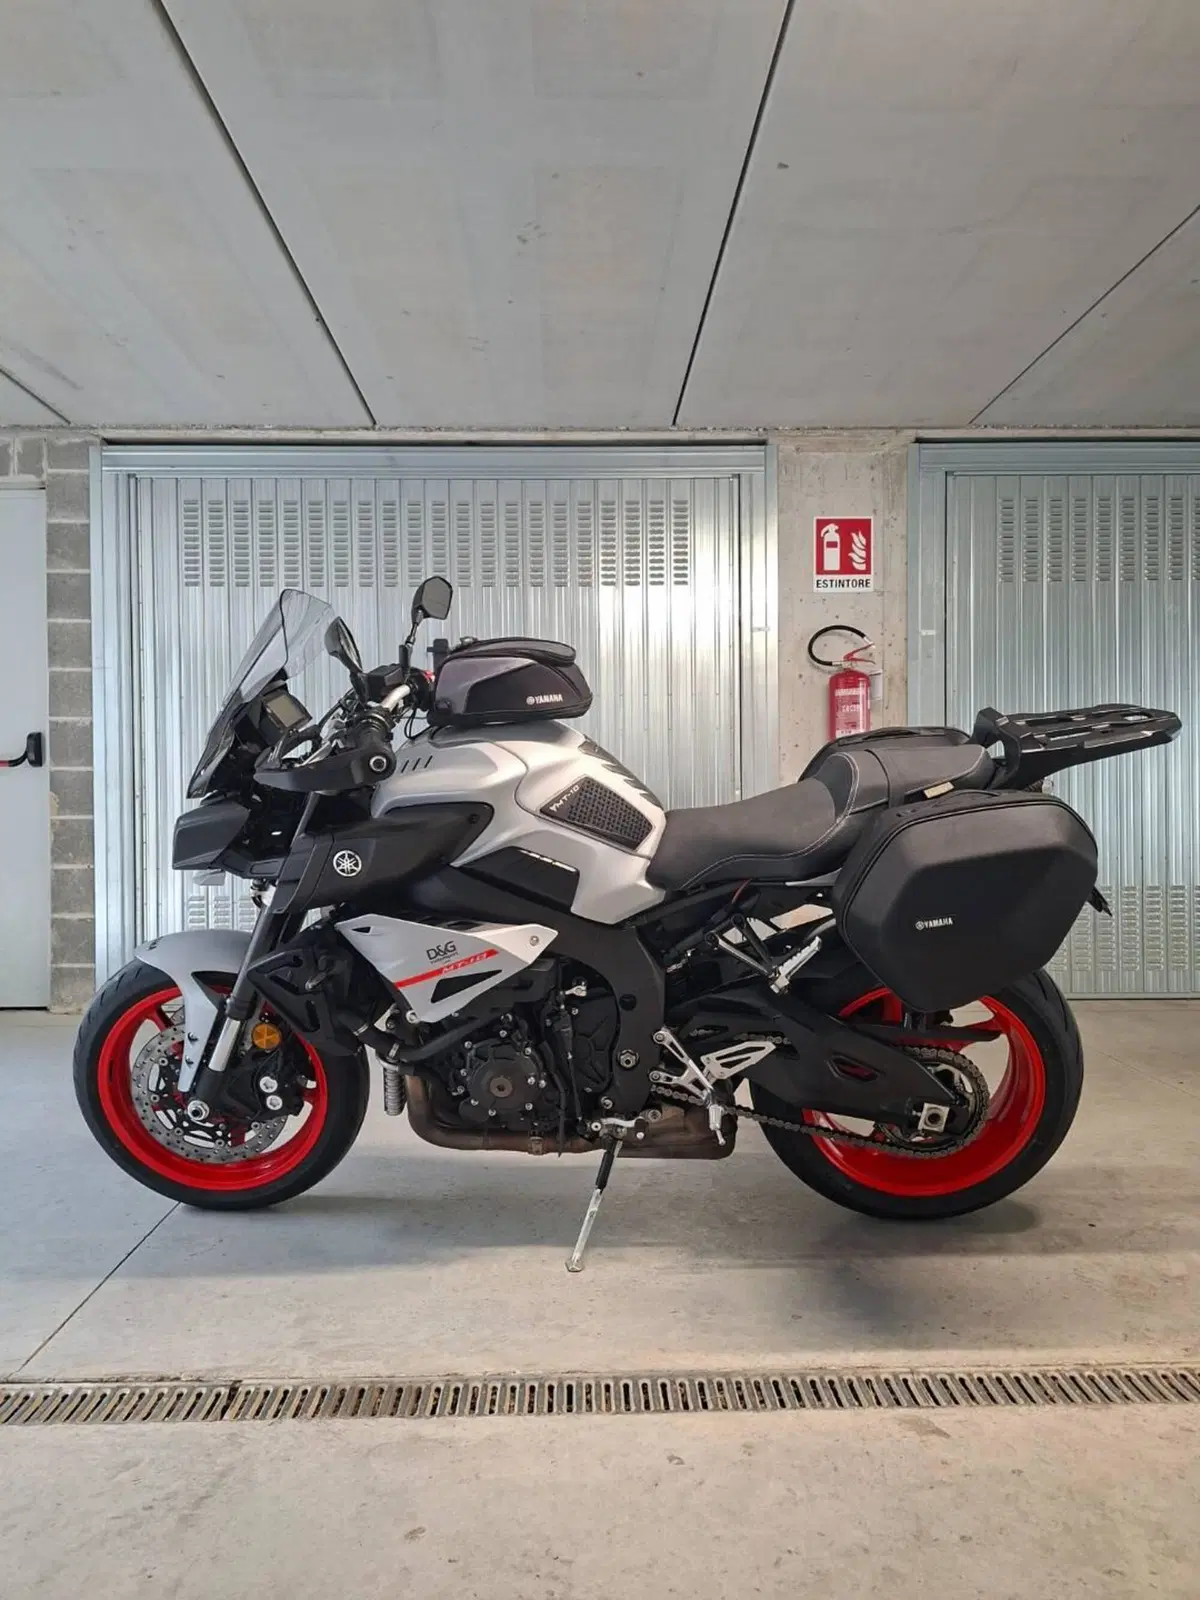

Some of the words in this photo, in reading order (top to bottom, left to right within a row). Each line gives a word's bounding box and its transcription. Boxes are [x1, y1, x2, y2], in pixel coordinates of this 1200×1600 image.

[816, 579, 871, 588] ESTINTORE
[535, 693, 563, 704] YAMAHA
[924, 917, 953, 928] YAMAHA
[426, 940, 457, 960] D&G
